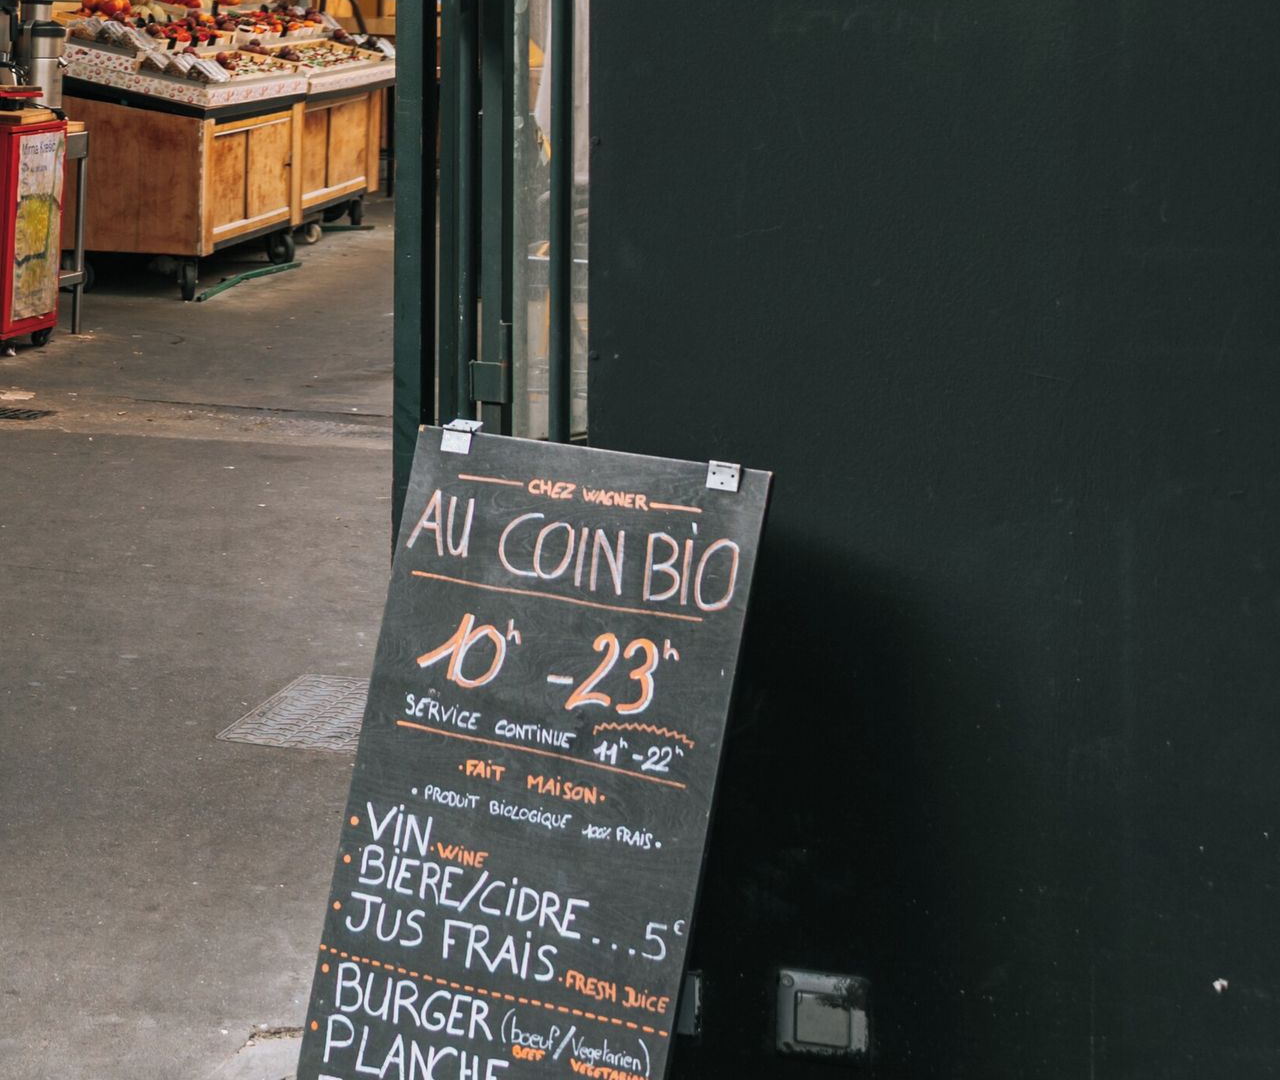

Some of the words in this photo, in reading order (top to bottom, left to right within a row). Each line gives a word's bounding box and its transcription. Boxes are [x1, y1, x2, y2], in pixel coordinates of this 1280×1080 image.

[406, 488, 476, 558] AU
[498, 512, 626, 596] COIN
[527, 478, 574, 500] CHEZ
[583, 486, 650, 512] WAGNER
[345, 891, 424, 948] JUS
[565, 970, 618, 1004] FRESH
[334, 960, 494, 1044] BURGER
